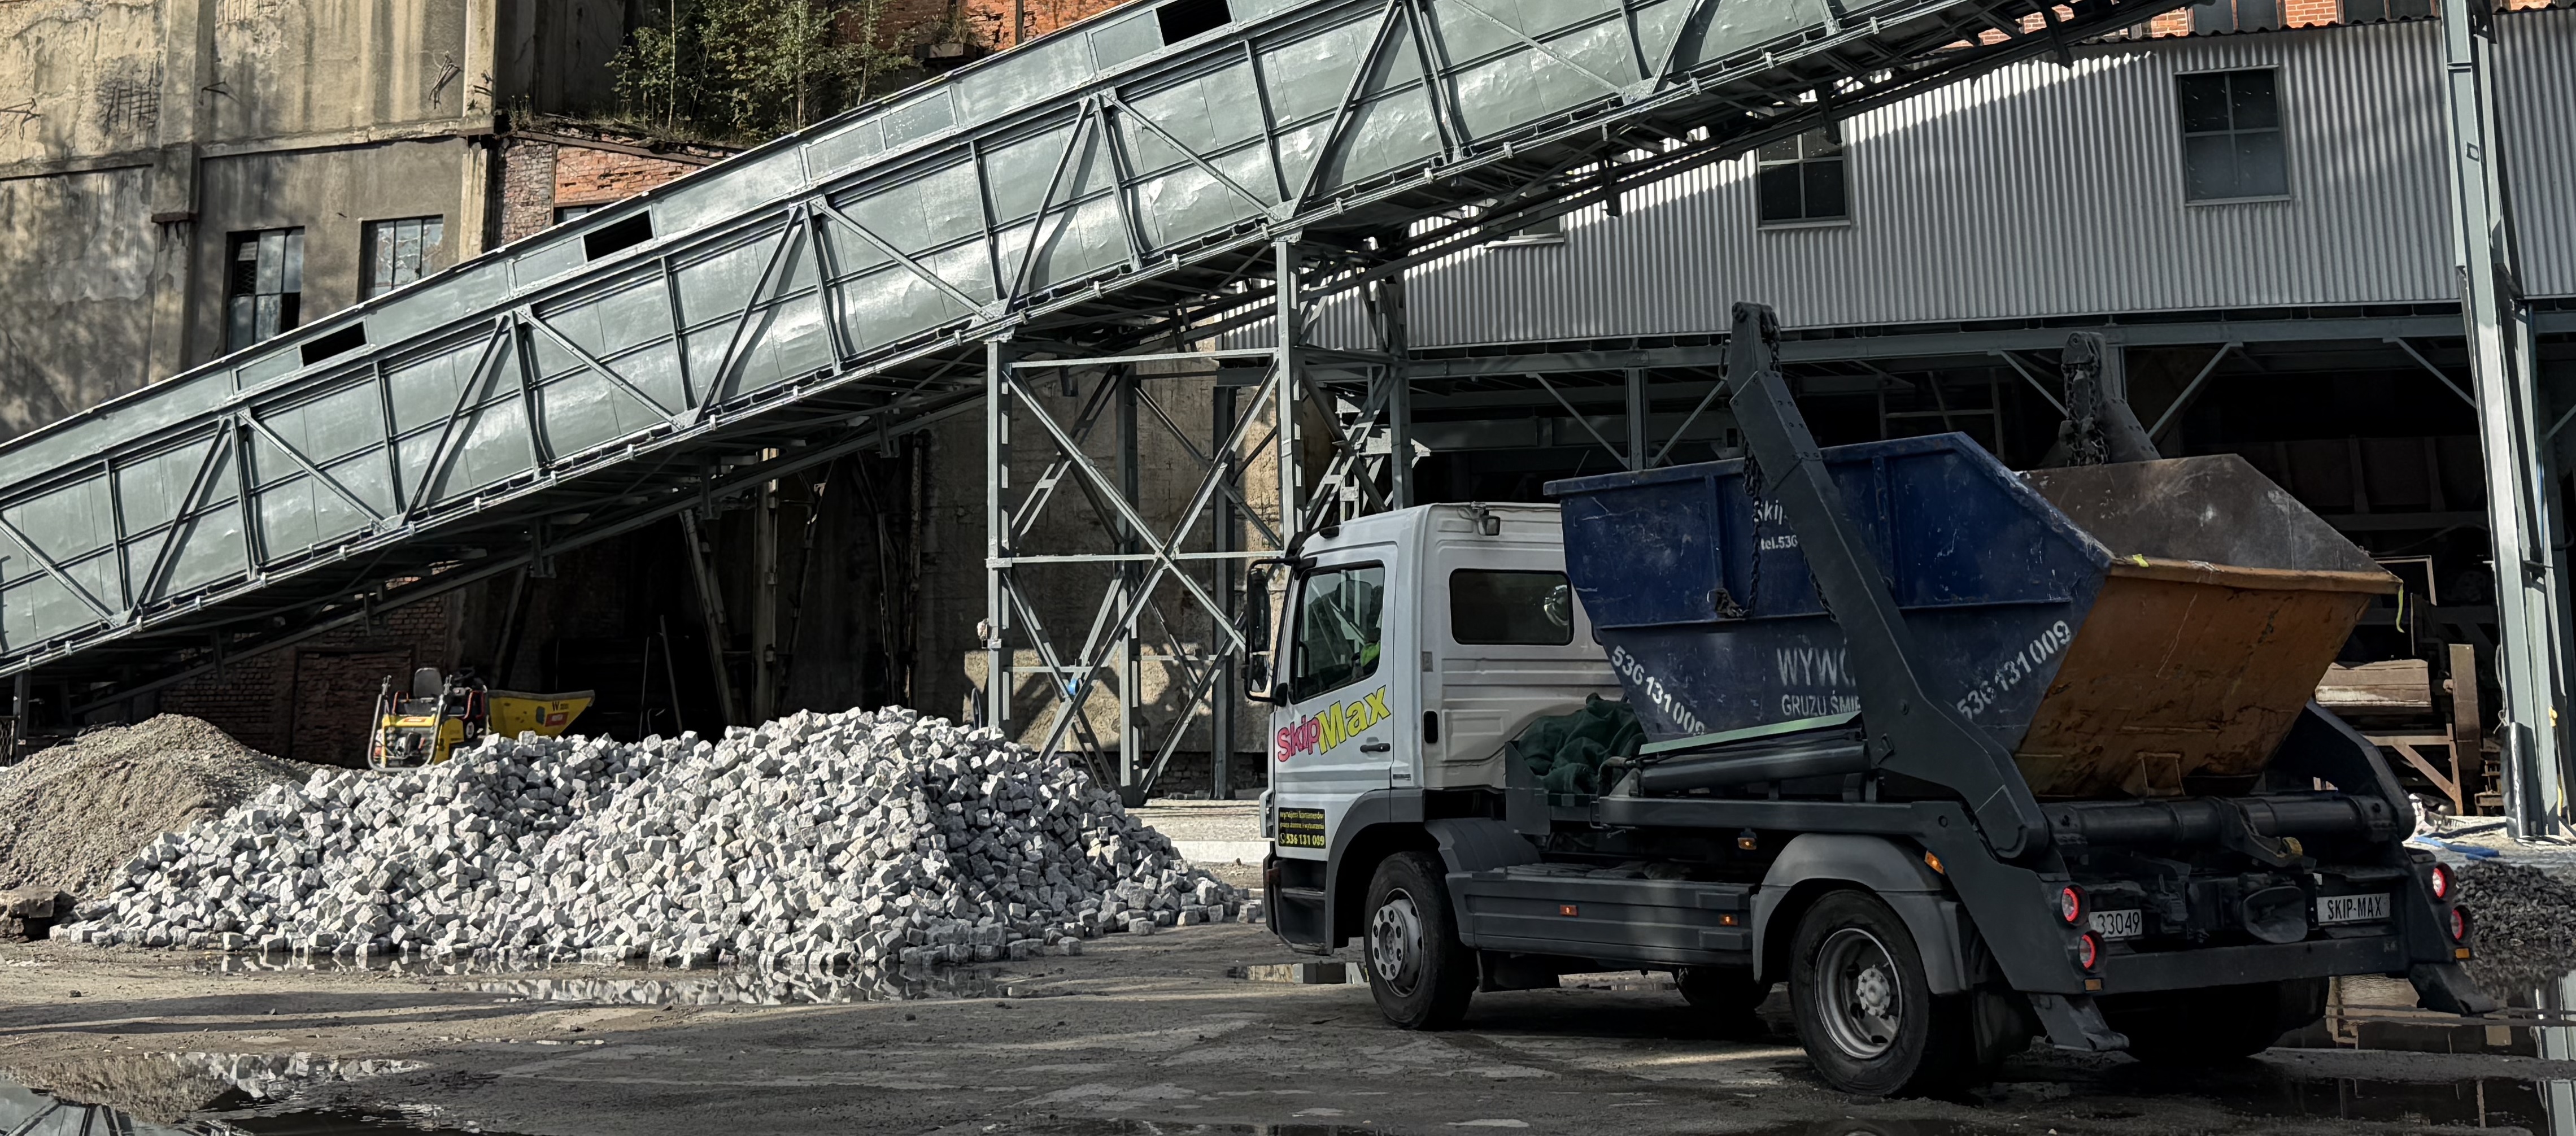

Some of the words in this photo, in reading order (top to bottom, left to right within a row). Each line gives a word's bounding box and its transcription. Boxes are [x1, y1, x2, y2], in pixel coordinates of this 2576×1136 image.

[1612, 645, 1645, 685] 536
[1646, 676, 1672, 713] 131
[1956, 680, 1996, 720] 536
[1995, 651, 2032, 691] 131
[2029, 620, 2071, 664] 009
[1782, 694, 1827, 716] GRUZU
[2097, 911, 2139, 935] 33049
